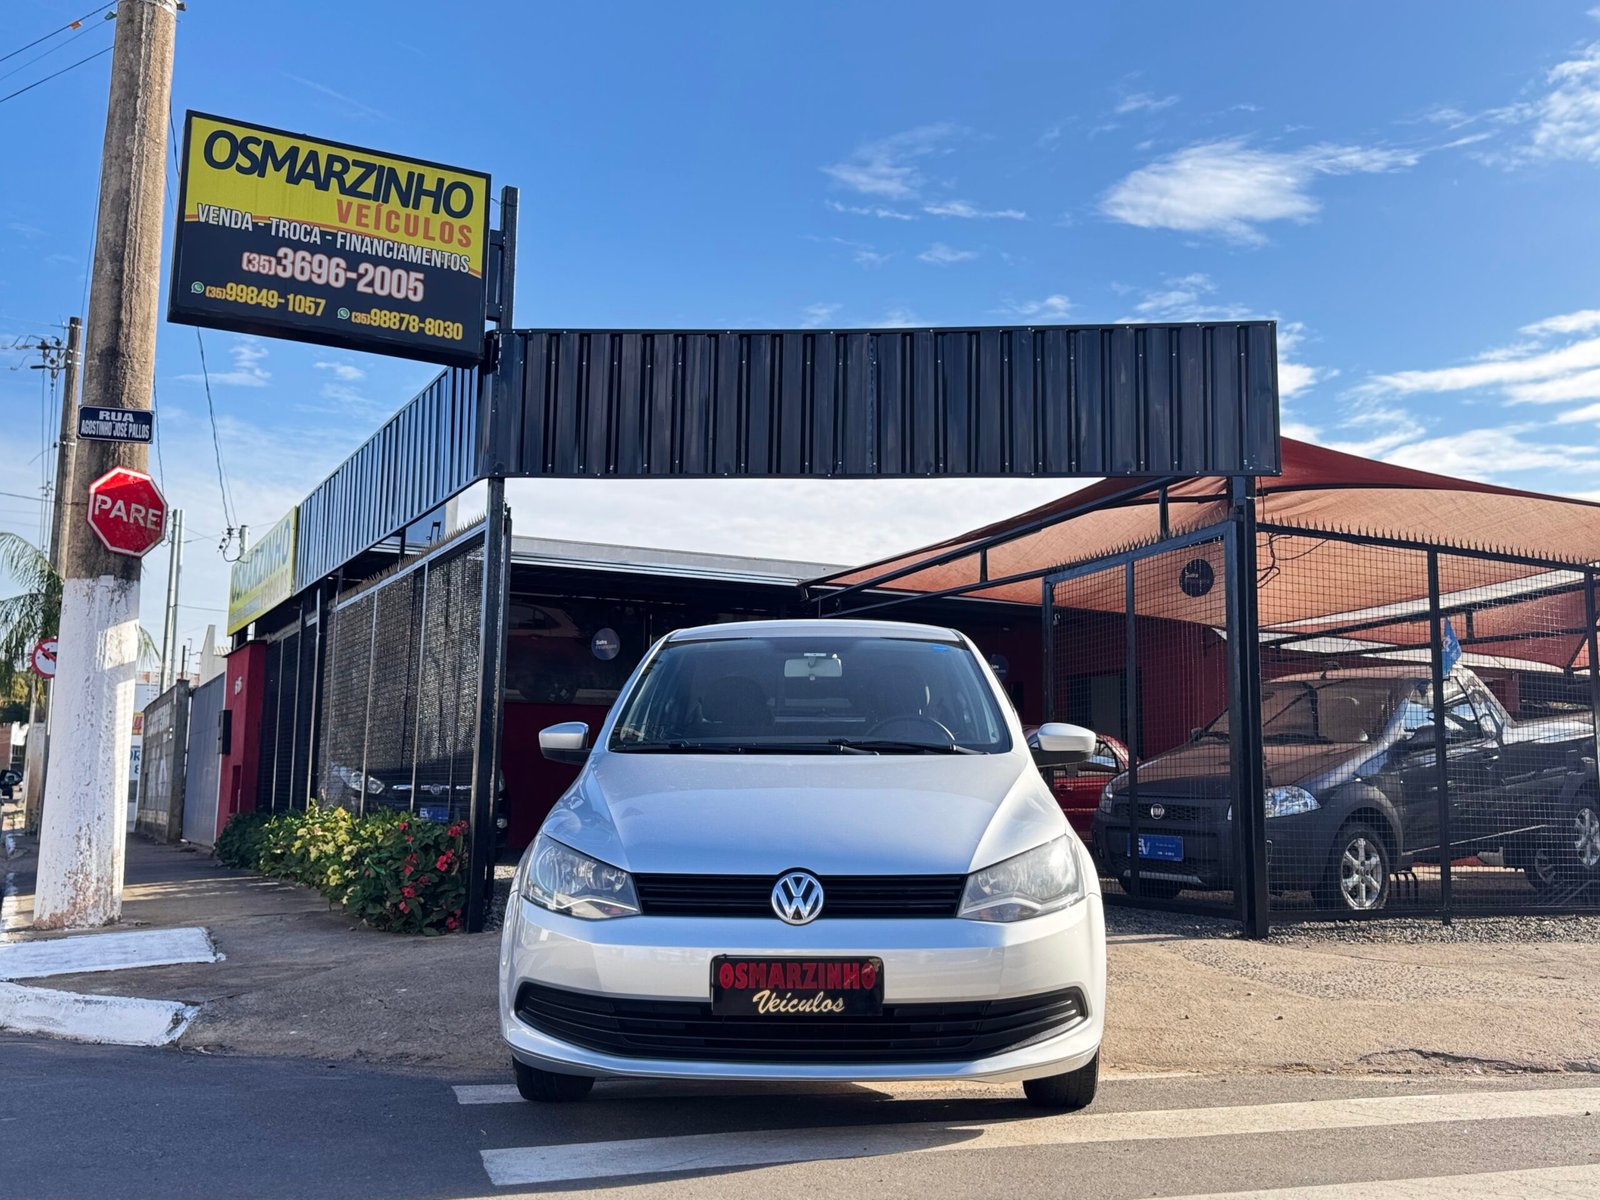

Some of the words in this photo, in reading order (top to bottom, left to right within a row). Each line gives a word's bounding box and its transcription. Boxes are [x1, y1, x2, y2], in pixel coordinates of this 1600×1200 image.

[203, 129, 474, 219] OSMARZINHO
[197, 203, 253, 231] VENDA
[269, 217, 321, 245] TROCA
[336, 231, 470, 273] FINANCIAMENTOS
[336, 198, 473, 249] VEÍCULOS
[98, 410, 135, 423] RUA
[94, 494, 162, 531] PARE
[719, 962, 877, 990] OSMARZINHO
[752, 989, 846, 1015] Veículos
